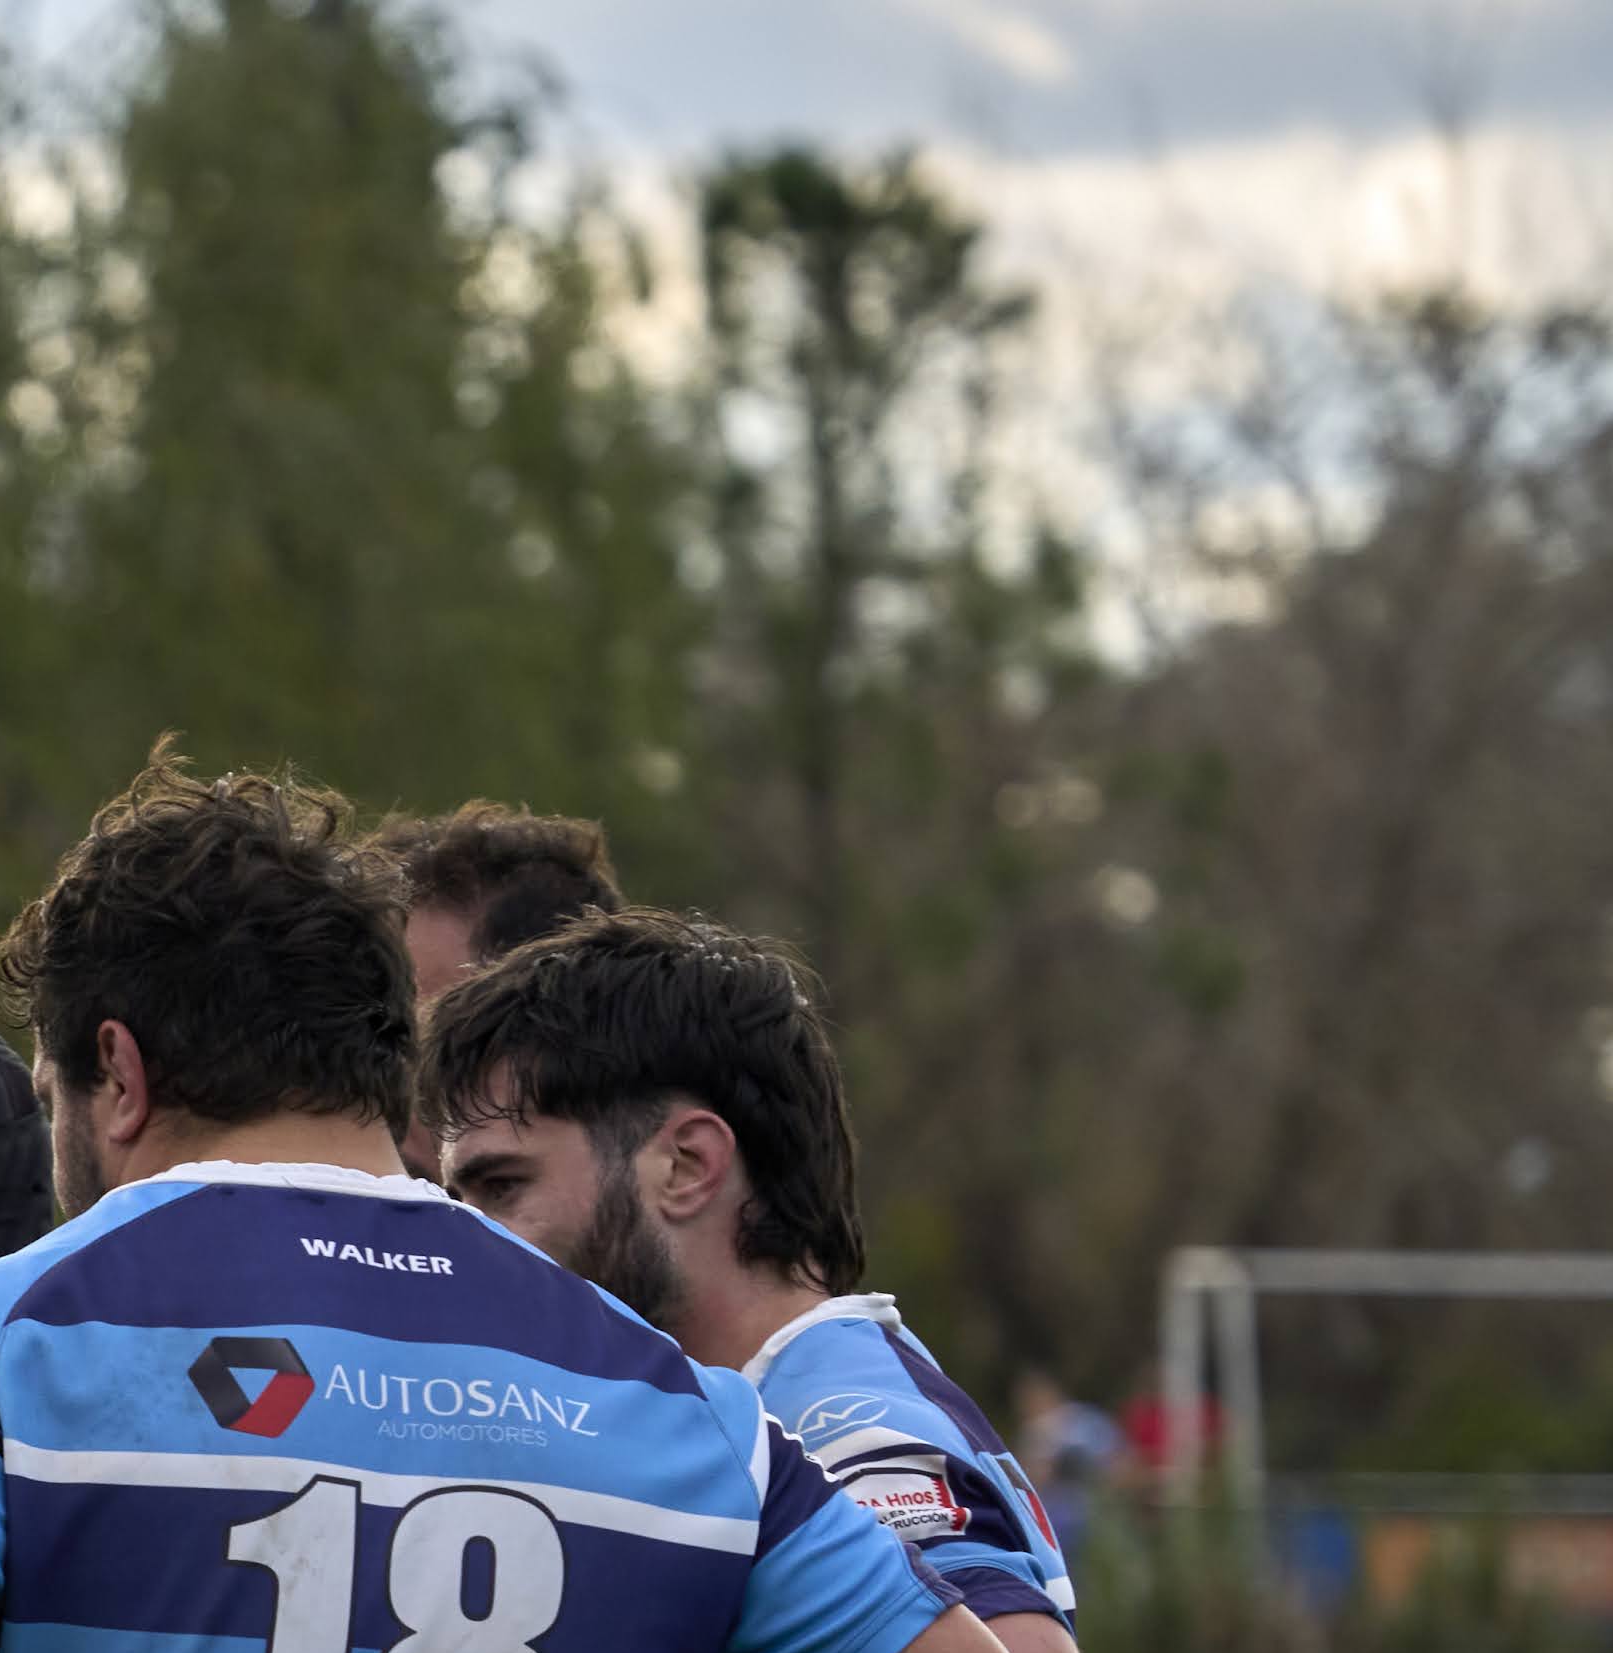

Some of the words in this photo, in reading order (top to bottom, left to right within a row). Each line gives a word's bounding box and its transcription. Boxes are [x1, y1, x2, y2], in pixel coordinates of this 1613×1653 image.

[300, 1236, 455, 1276] WALKER
[324, 1363, 600, 1437] AUTOSANZ
[377, 1419, 549, 1448] AUTOMOTORES
[885, 1490, 935, 1507] Hnos
